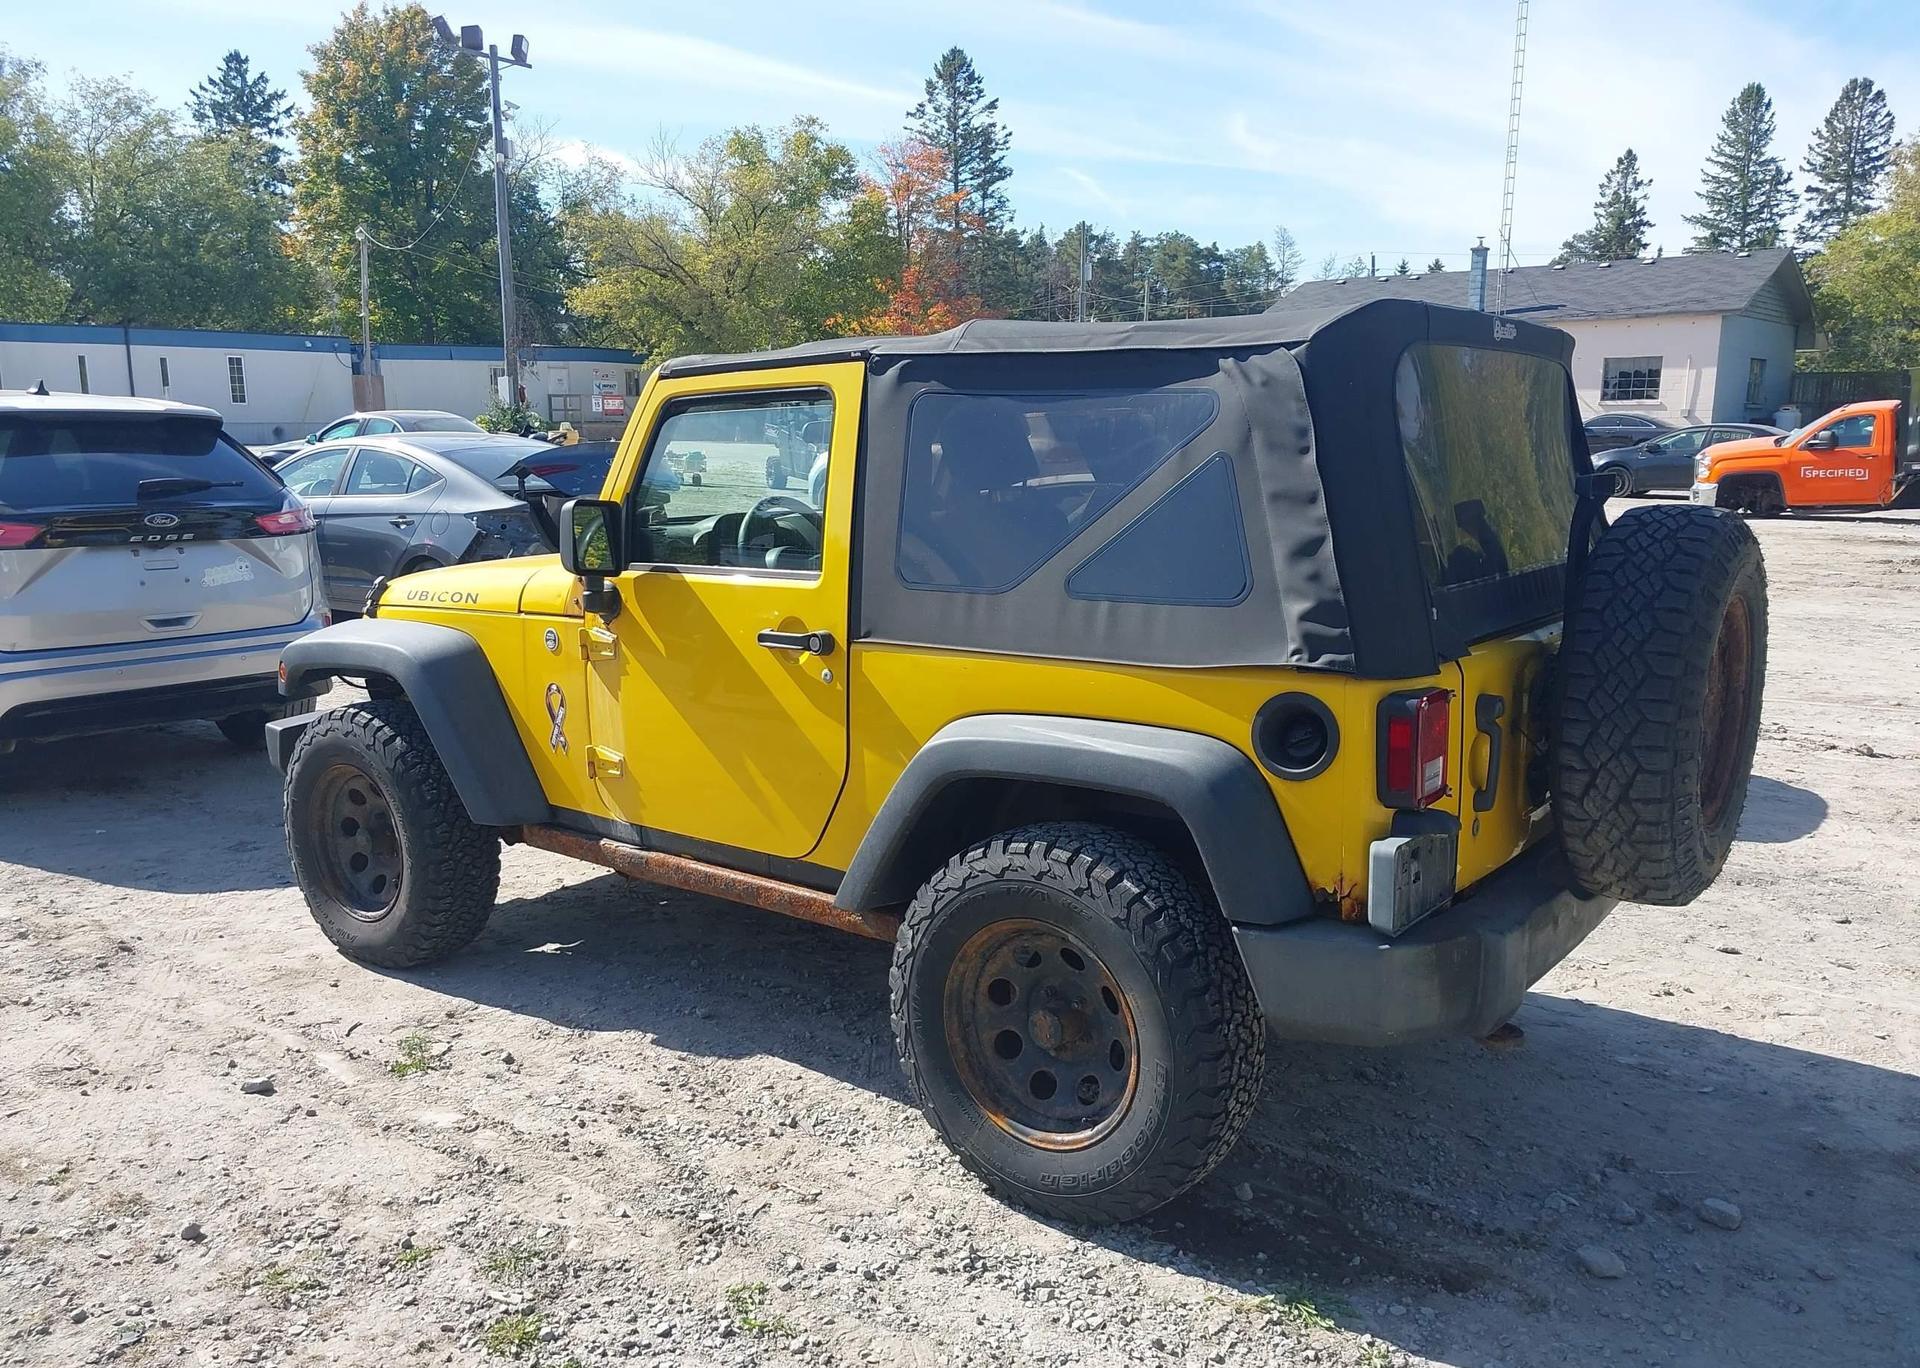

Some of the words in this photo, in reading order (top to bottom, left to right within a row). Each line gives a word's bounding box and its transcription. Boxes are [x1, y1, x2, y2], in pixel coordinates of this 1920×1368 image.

[1804, 467, 1865, 478] SPECIFIED
[129, 533, 195, 542] EDGE
[406, 590, 479, 604] UBICON
